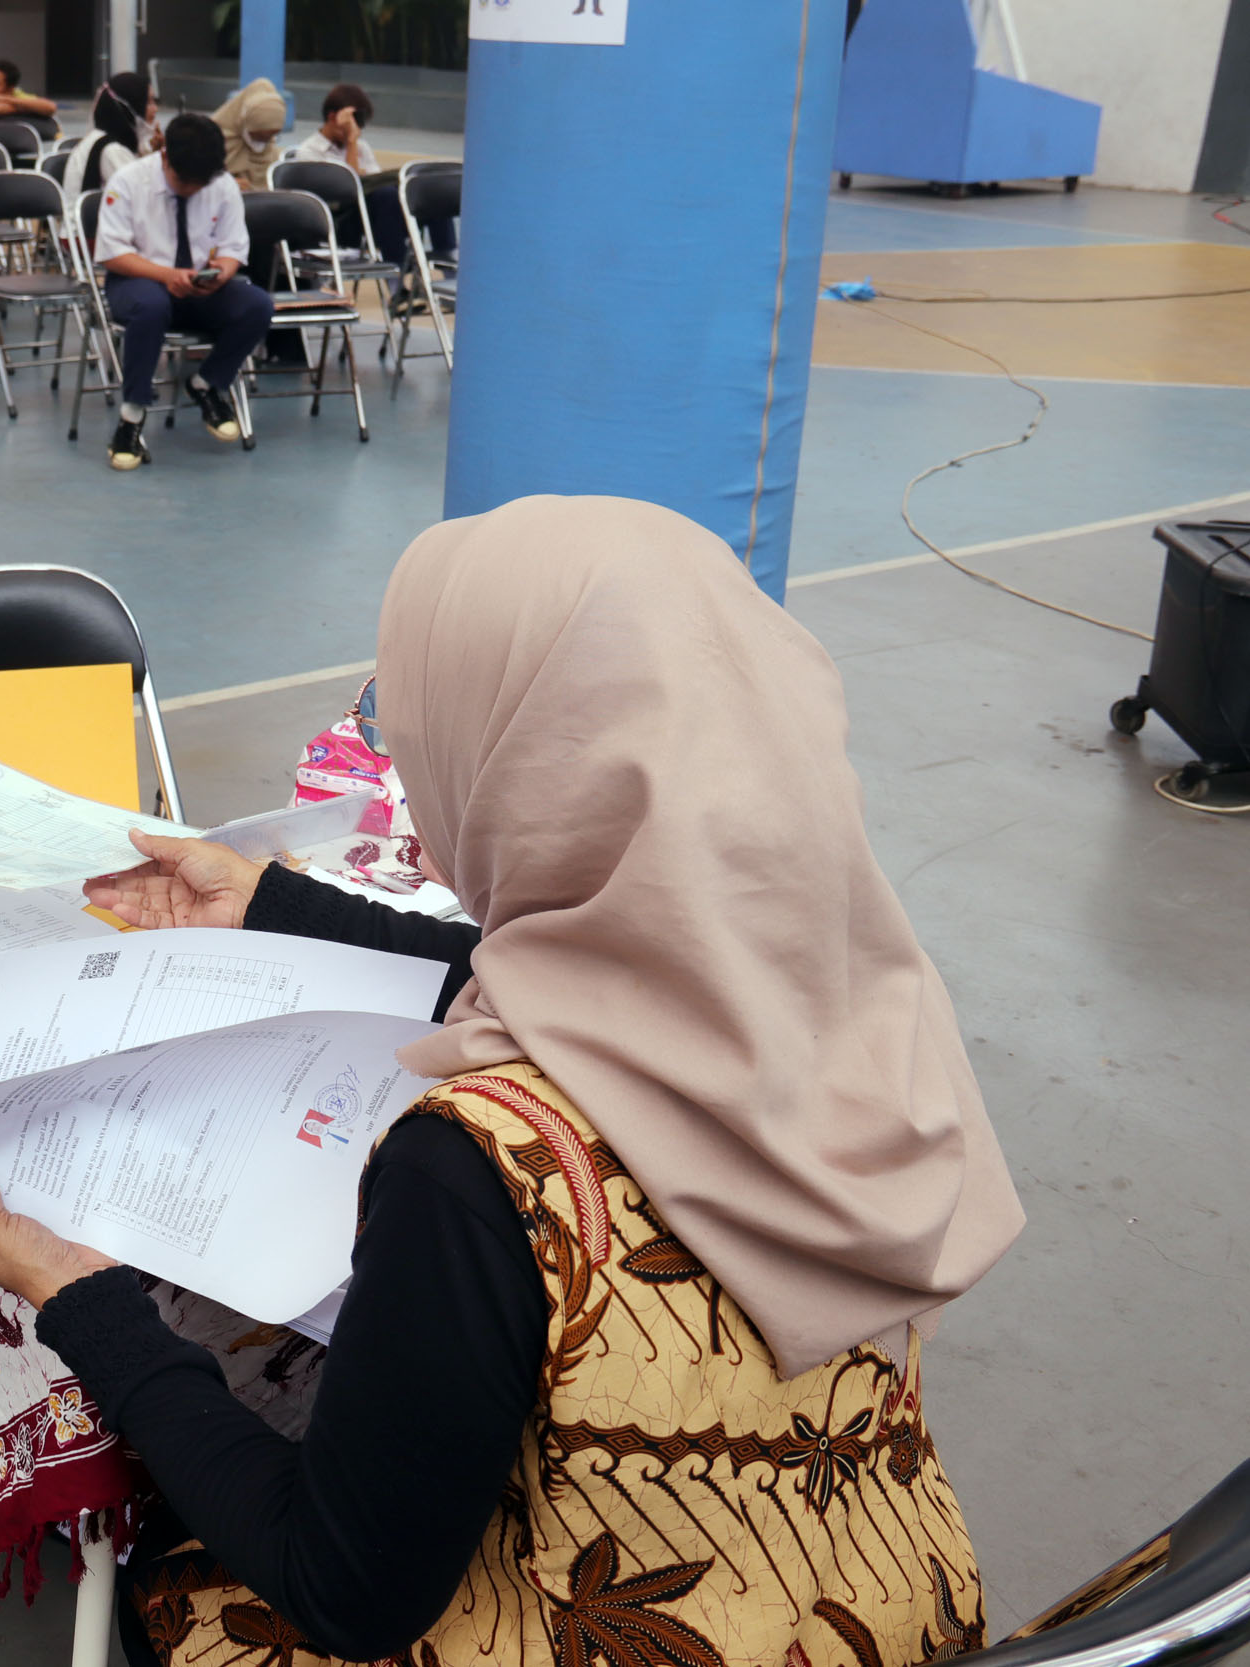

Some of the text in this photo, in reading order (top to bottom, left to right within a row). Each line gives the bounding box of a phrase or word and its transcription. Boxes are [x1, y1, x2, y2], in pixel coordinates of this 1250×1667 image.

[129, 1097, 140, 1111] Mata
[366, 1120, 375, 1132] NIP
[73, 1197, 82, 1212] SMP
[78, 1170, 91, 1197] NEGERI
[90, 1126, 107, 1162] SURABAYA
